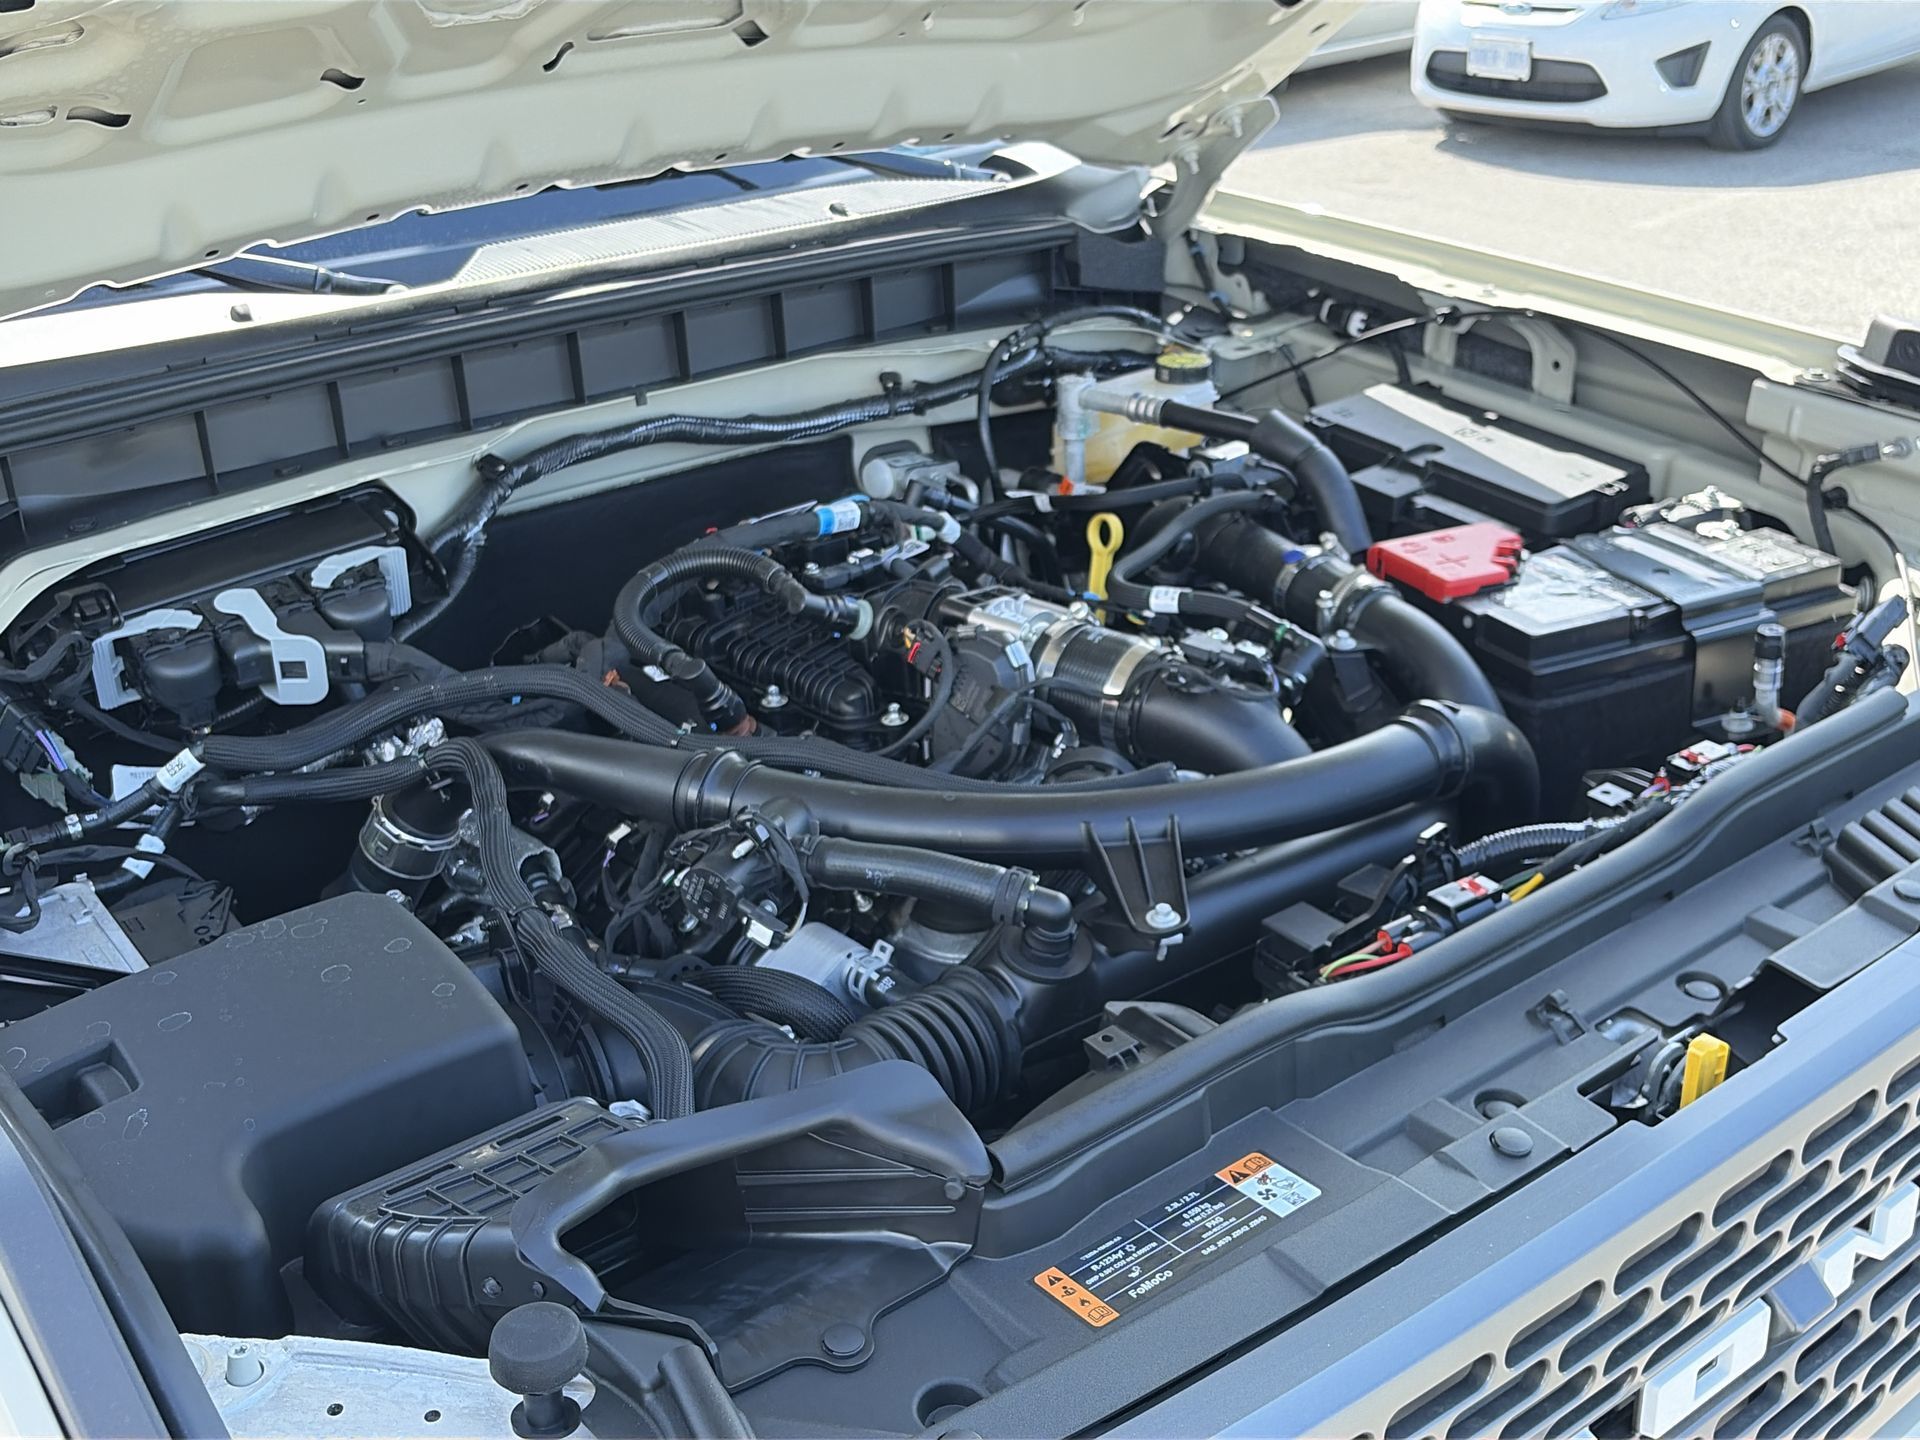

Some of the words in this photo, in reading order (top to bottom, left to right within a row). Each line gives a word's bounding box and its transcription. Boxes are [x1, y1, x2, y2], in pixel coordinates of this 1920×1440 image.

[1183, 1191, 1200, 1202] 2.7L
[1205, 1216, 1224, 1228] PAG
[1090, 1249, 1126, 1272] R-1234yf
[1127, 1270, 1174, 1298] FoMoCo
